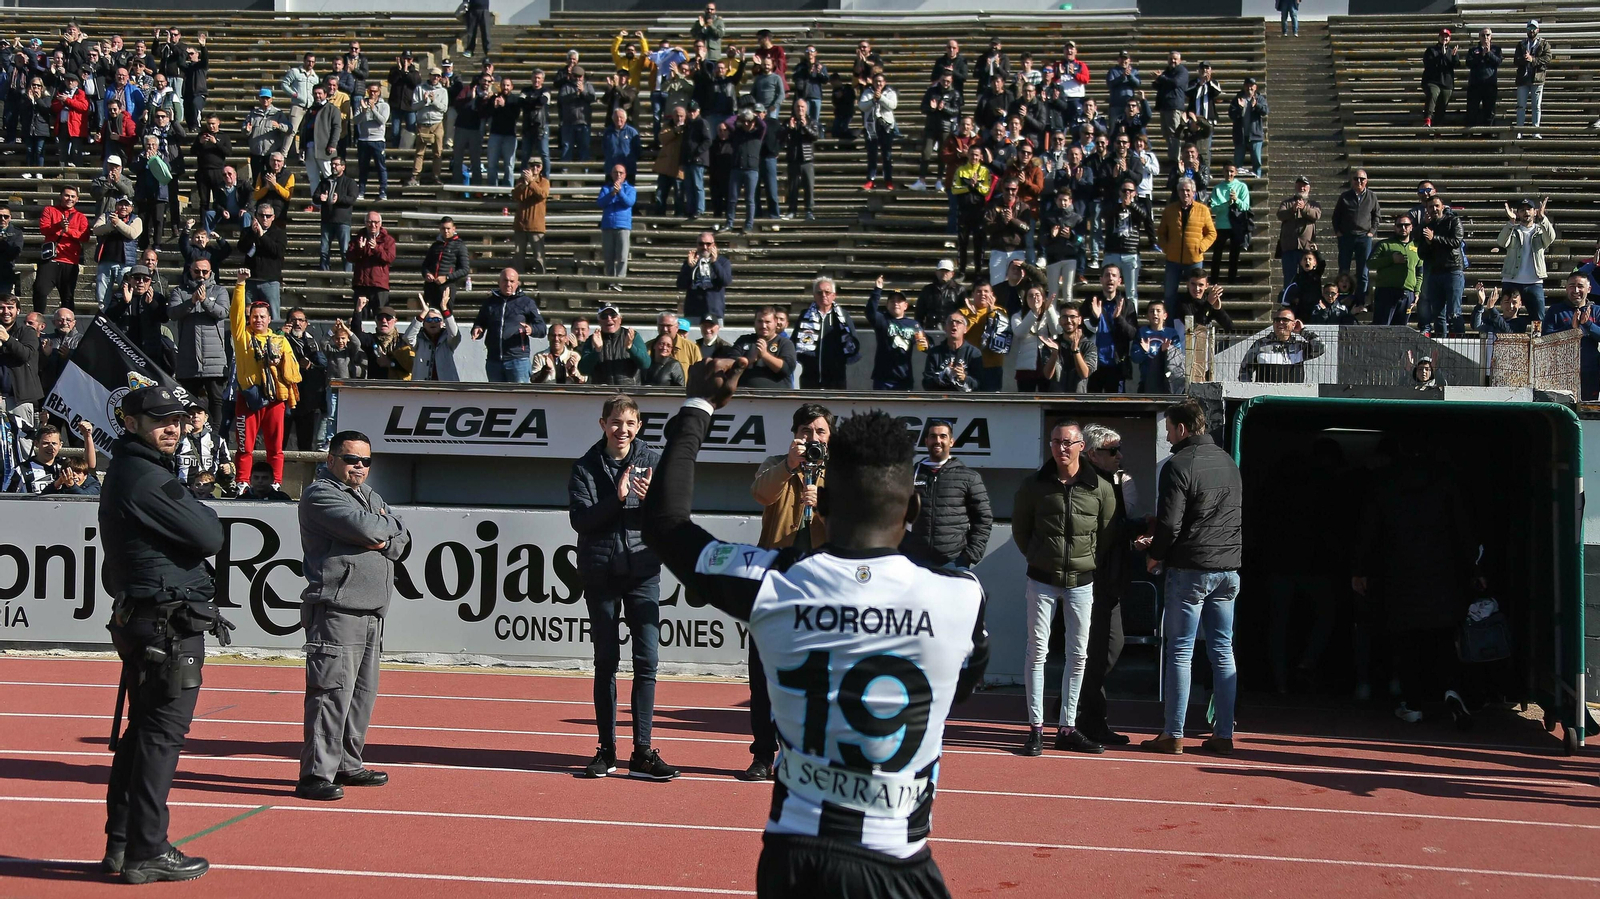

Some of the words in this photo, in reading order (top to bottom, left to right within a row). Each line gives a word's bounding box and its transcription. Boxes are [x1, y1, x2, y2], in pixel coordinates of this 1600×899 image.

[95, 316, 147, 368] Sentimiento
[236, 415, 247, 453] TOMMY
[384, 406, 549, 439] LEGEA
[637, 412, 767, 446] EEA
[0, 527, 114, 620] onj
[0, 601, 29, 628] ÍA
[793, 604, 935, 638] KOROMA
[494, 615, 724, 649] CONSTRCONES
[735, 621, 749, 650] Y
[776, 649, 934, 773] 19
